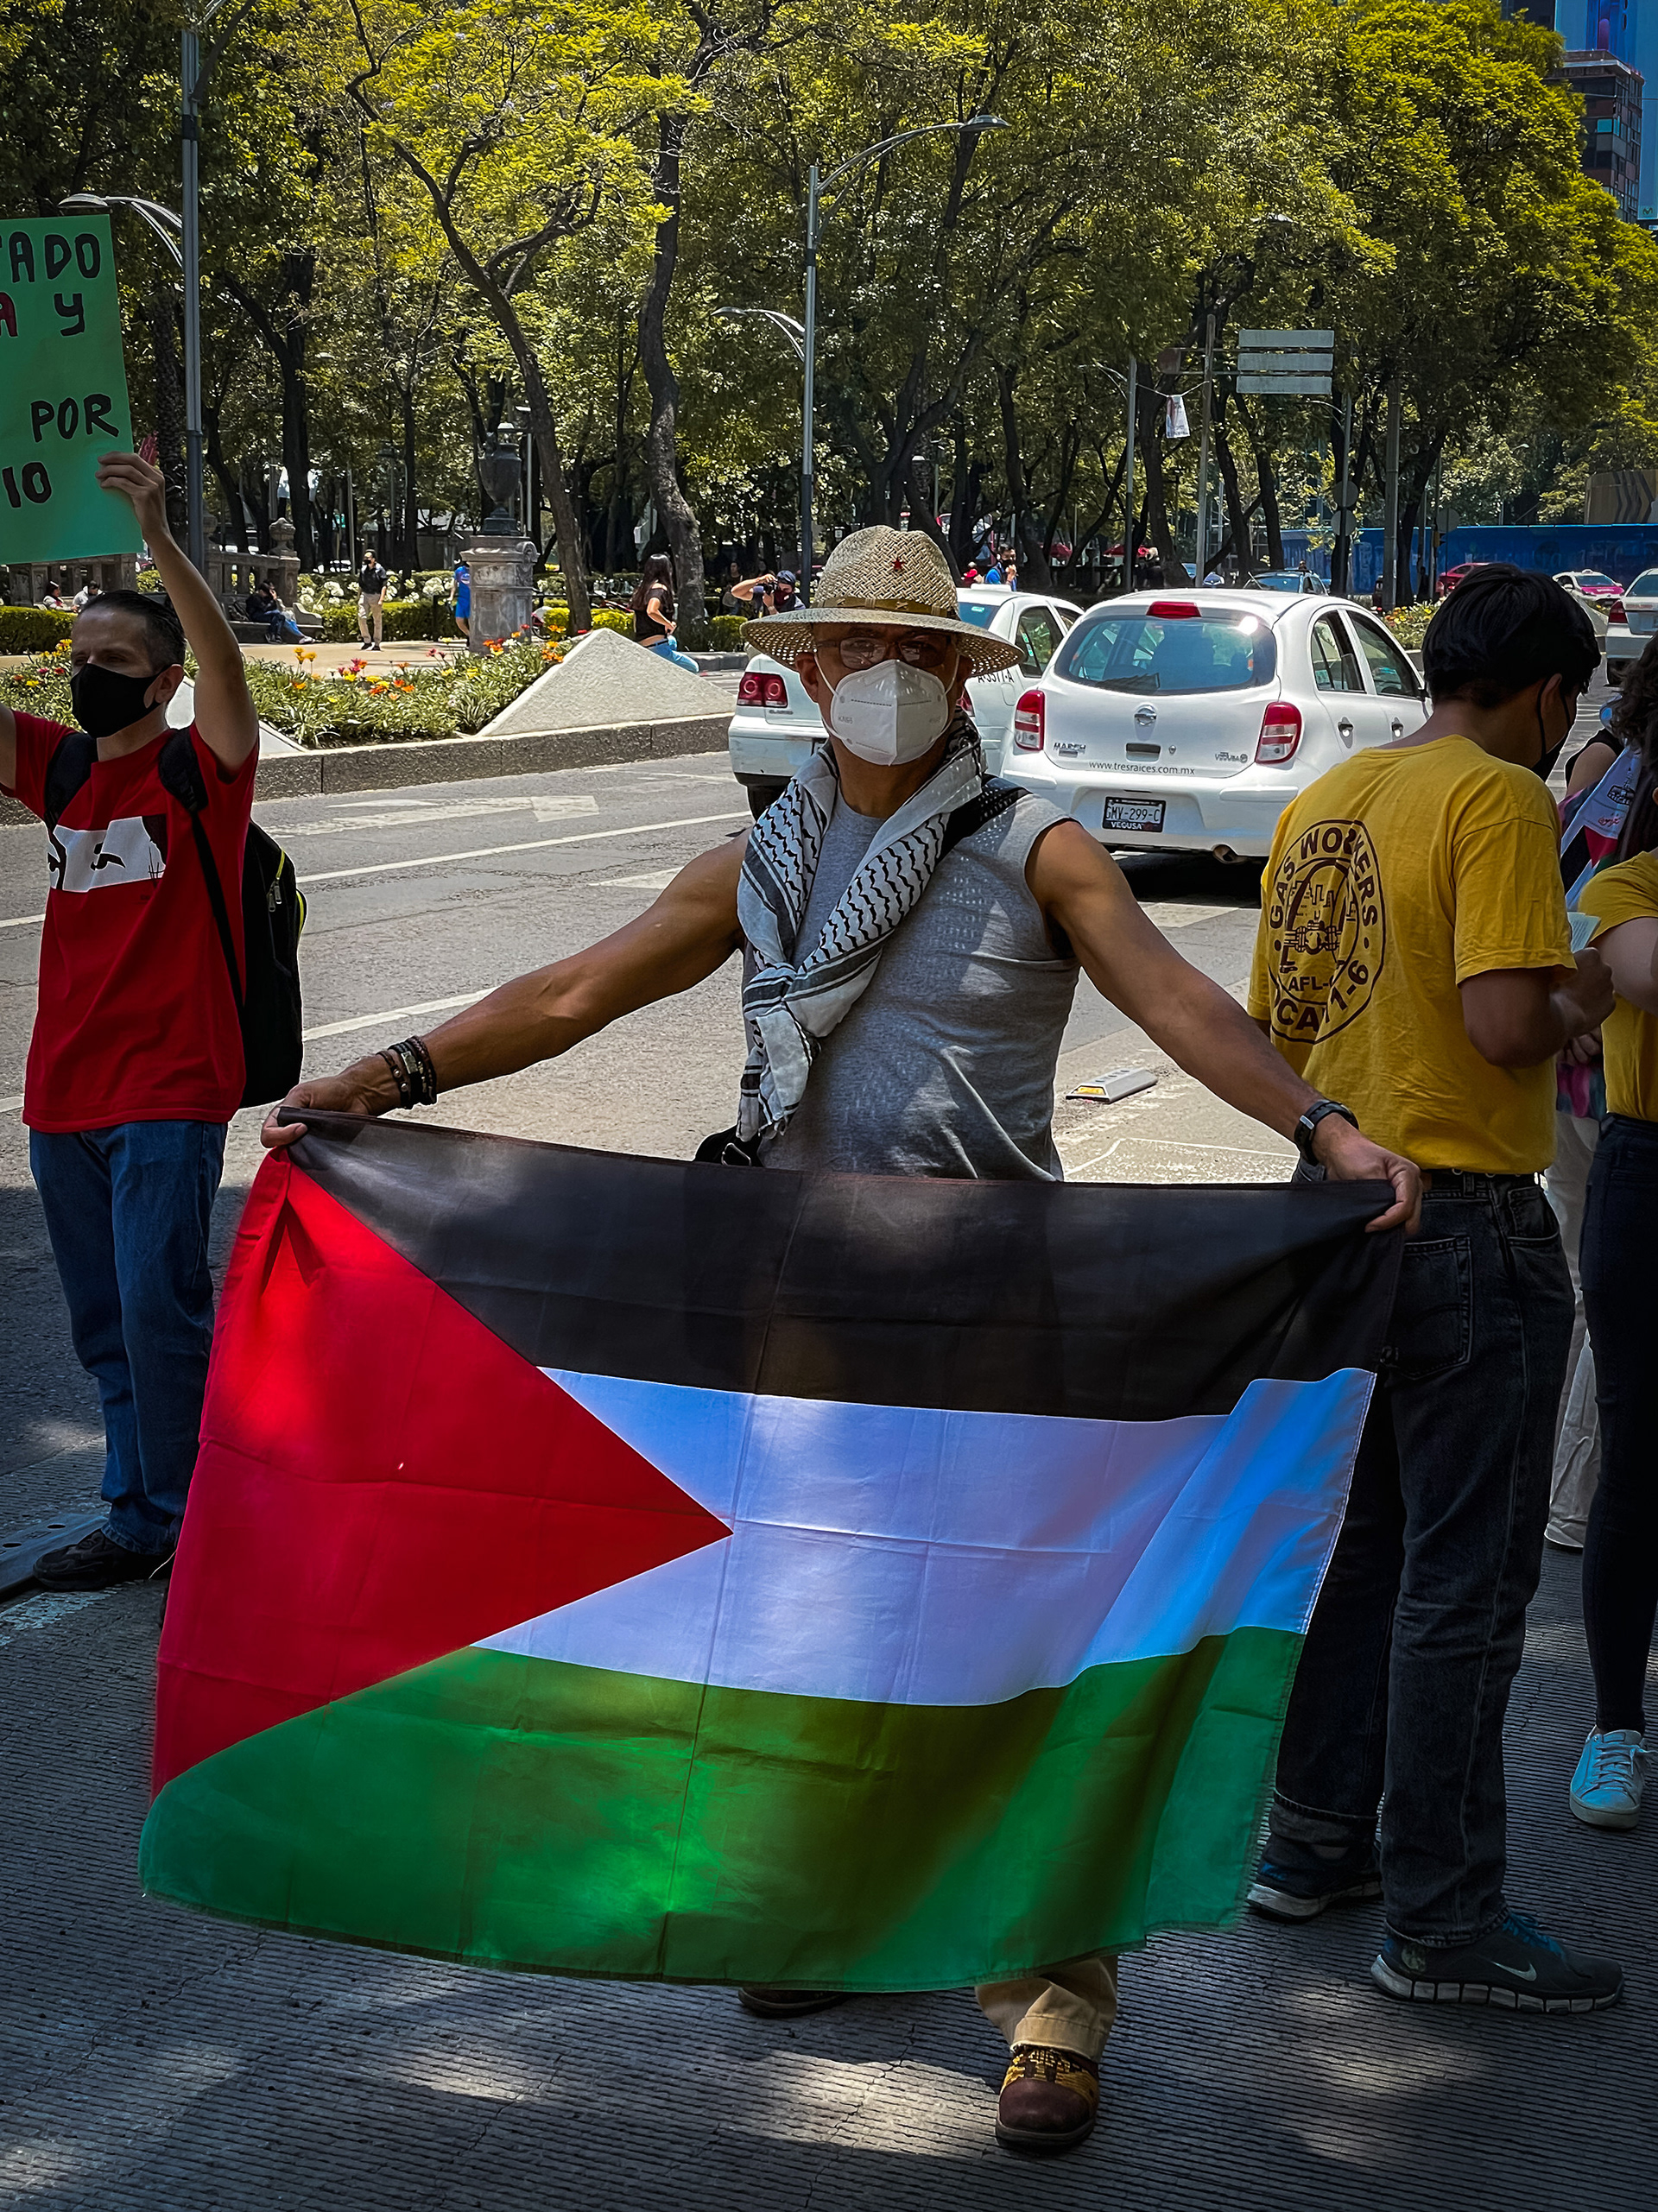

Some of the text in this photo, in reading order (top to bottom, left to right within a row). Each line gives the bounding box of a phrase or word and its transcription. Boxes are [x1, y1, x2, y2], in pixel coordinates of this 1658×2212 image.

[0, 231, 101, 283] ADO
[31, 394, 119, 442] POR
[1088, 761, 1195, 775] www.tresraices.com.mx
[1269, 856, 1295, 929] GAS
